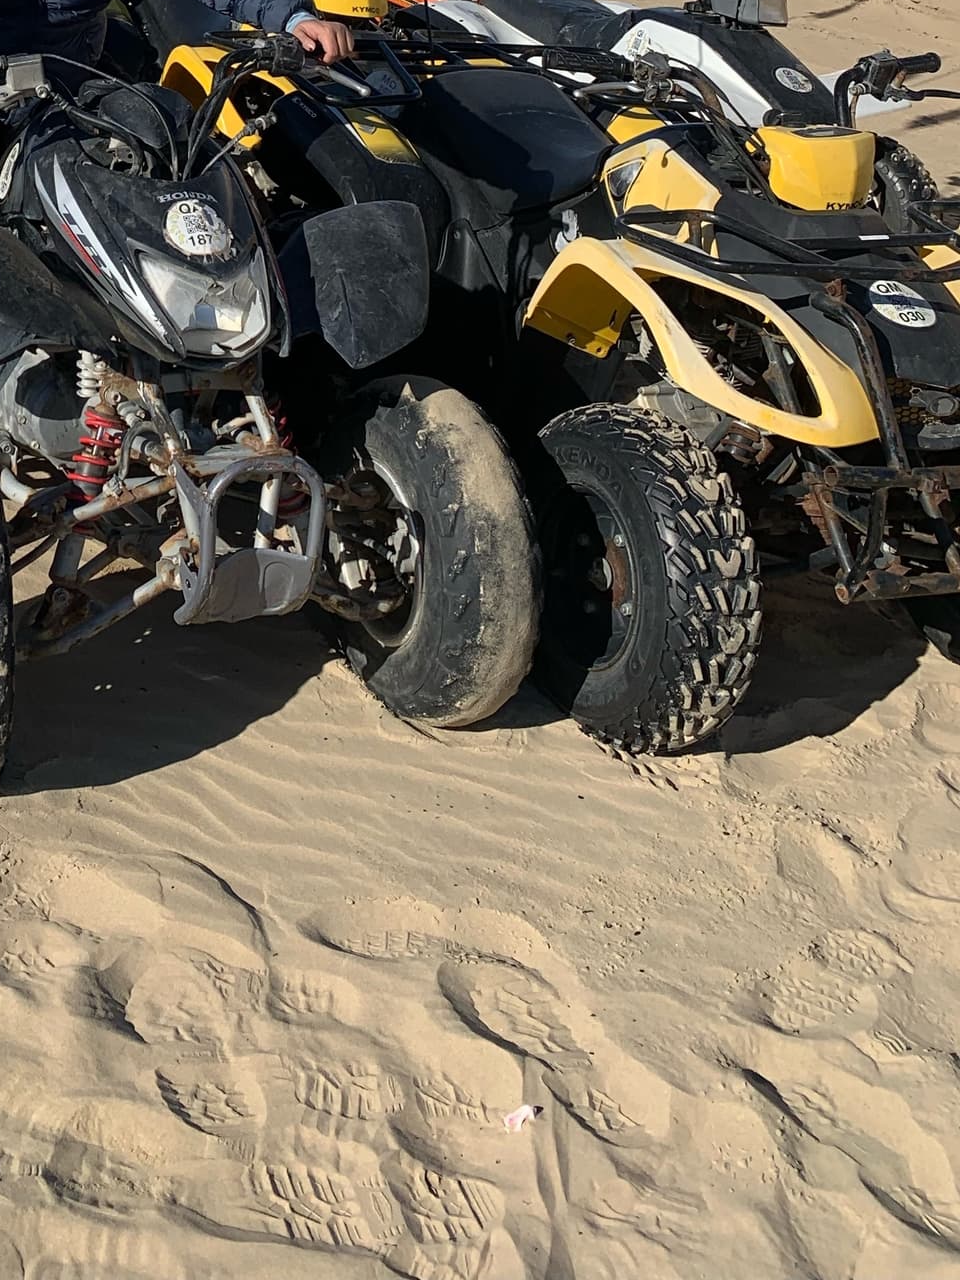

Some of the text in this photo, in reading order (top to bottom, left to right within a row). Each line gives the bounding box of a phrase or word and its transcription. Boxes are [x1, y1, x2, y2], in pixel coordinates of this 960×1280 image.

[352, 6, 380, 14] KYMCO
[157, 191, 219, 203] HONDA
[188, 233, 213, 247] 187
[876, 283, 902, 294] QM
[898, 311, 926, 322] 030
